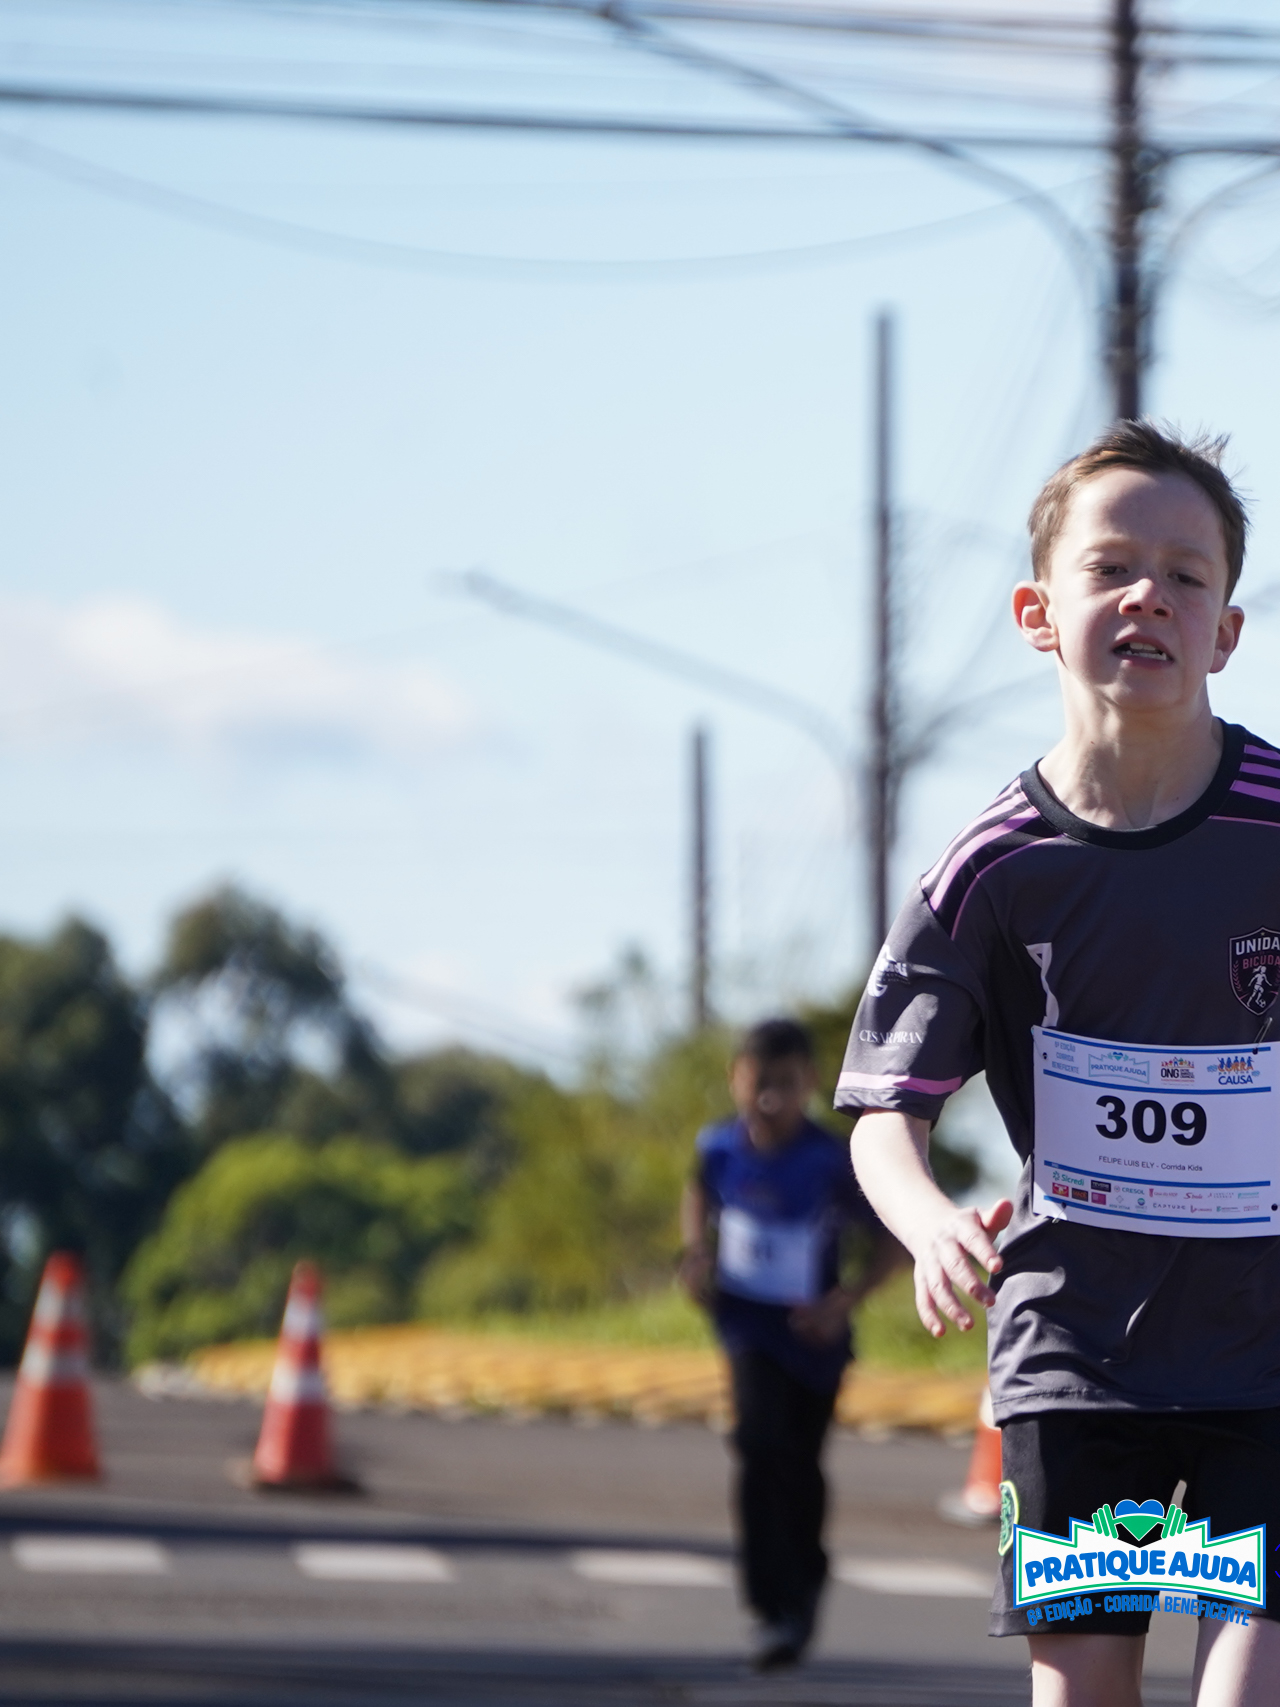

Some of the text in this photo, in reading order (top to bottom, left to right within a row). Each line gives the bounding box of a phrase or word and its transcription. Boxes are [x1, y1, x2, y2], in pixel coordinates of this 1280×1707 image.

[1090, 1063, 1147, 1077] PRATIQUE AJUDA
[1160, 1067, 1180, 1079] ONG
[1217, 1074, 1254, 1086] CAUSA
[1095, 1094, 1208, 1147] 309
[1098, 1155, 1122, 1166] FELIPE
[1123, 1159, 1140, 1168] LUIS
[1141, 1161, 1155, 1169] ELY
[1160, 1162, 1186, 1172] Corrida
[1187, 1164, 1204, 1172] Kids
[1061, 1173, 1085, 1187] Sicredi
[1121, 1187, 1145, 1196] CRESOL
[1152, 1202, 1186, 1210] CAPTURE
